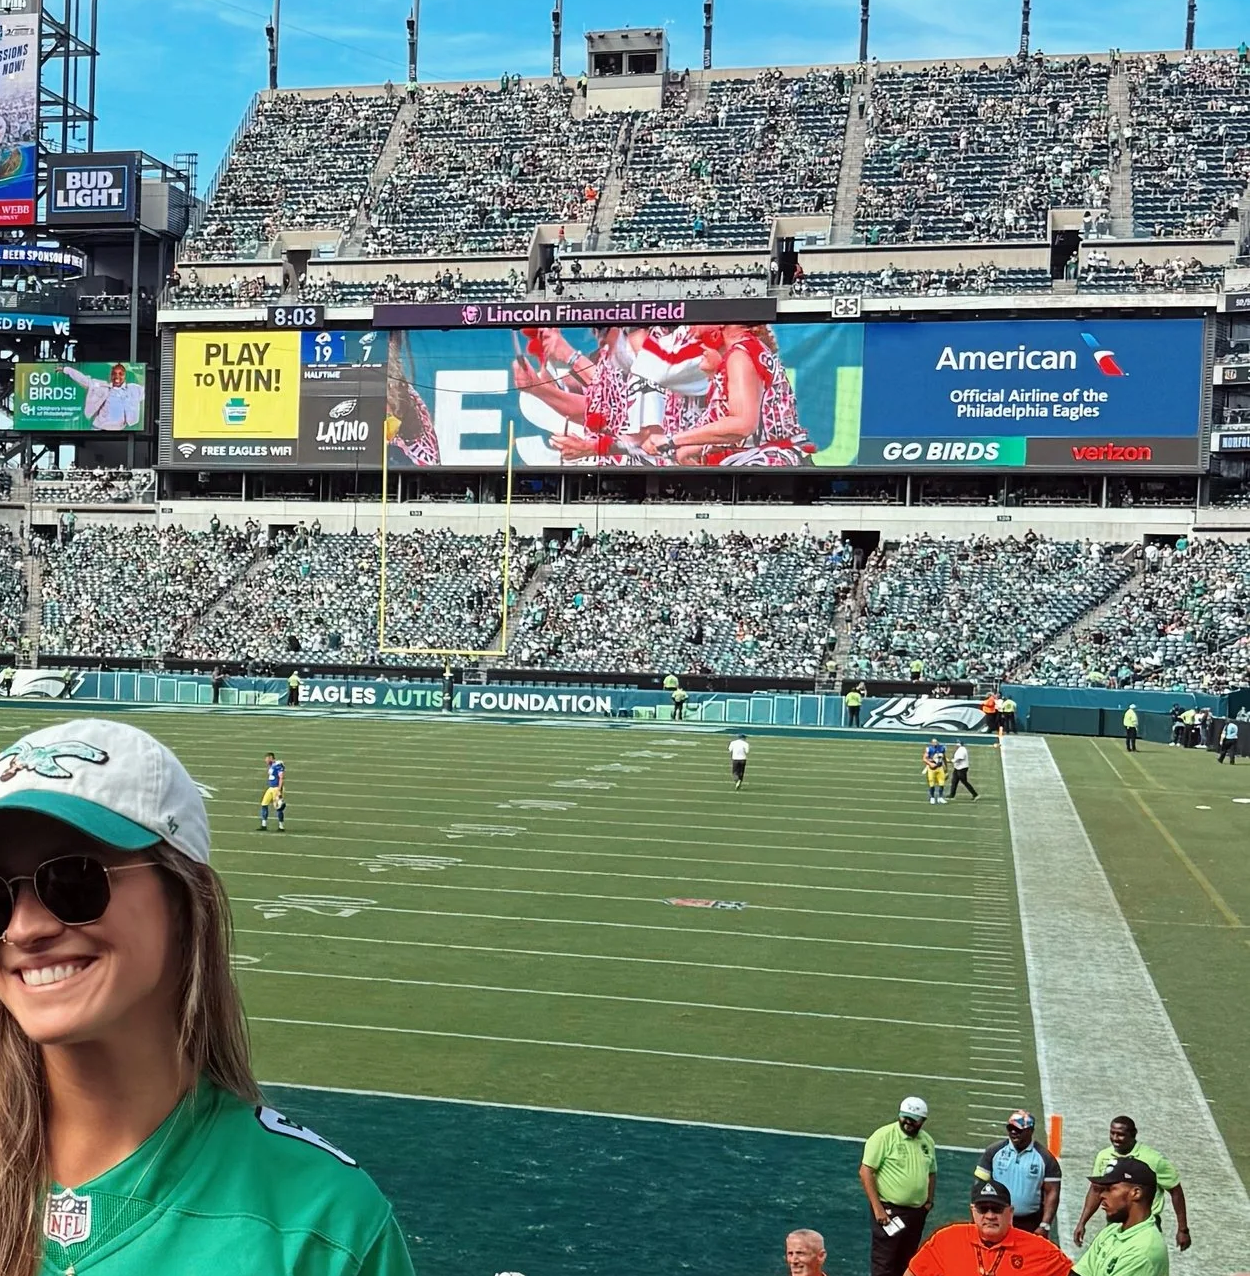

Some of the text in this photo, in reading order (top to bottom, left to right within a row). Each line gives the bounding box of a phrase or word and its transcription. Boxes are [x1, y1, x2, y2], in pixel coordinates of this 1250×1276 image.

[2, 59, 26, 75] NOW!
[66, 171, 113, 189] BUD
[57, 189, 122, 207] LIGHT
[1, 205, 30, 215] WEBB
[3, 248, 25, 260] BEER
[27, 250, 63, 264] SPONSOR
[487, 302, 685, 322] Lincoln Financial Field
[836, 298, 858, 316] 25
[17, 318, 34, 331] BY
[274, 308, 316, 325] 8:03
[205, 343, 271, 366] PLAY
[315, 346, 332, 362] 19
[363, 346, 372, 362] 7
[936, 345, 1076, 371] American
[29, 373, 50, 385] GO
[194, 369, 281, 392] TO WIN!
[304, 371, 340, 379] HALFTIME
[30, 387, 76, 401] BIRDS!
[950, 389, 1108, 402] Official Airline of the
[957, 404, 1100, 422] Philadelphia Eagles
[316, 420, 369, 443] LATINO
[201, 446, 292, 456] FREE EAGLES WIFI
[883, 442, 999, 461] GO BIRDS
[1072, 443, 1152, 462] verizon
[299, 685, 376, 705] EAGLES
[469, 691, 611, 713] FOUNDATION
[51, 1214, 82, 1238] NFL
